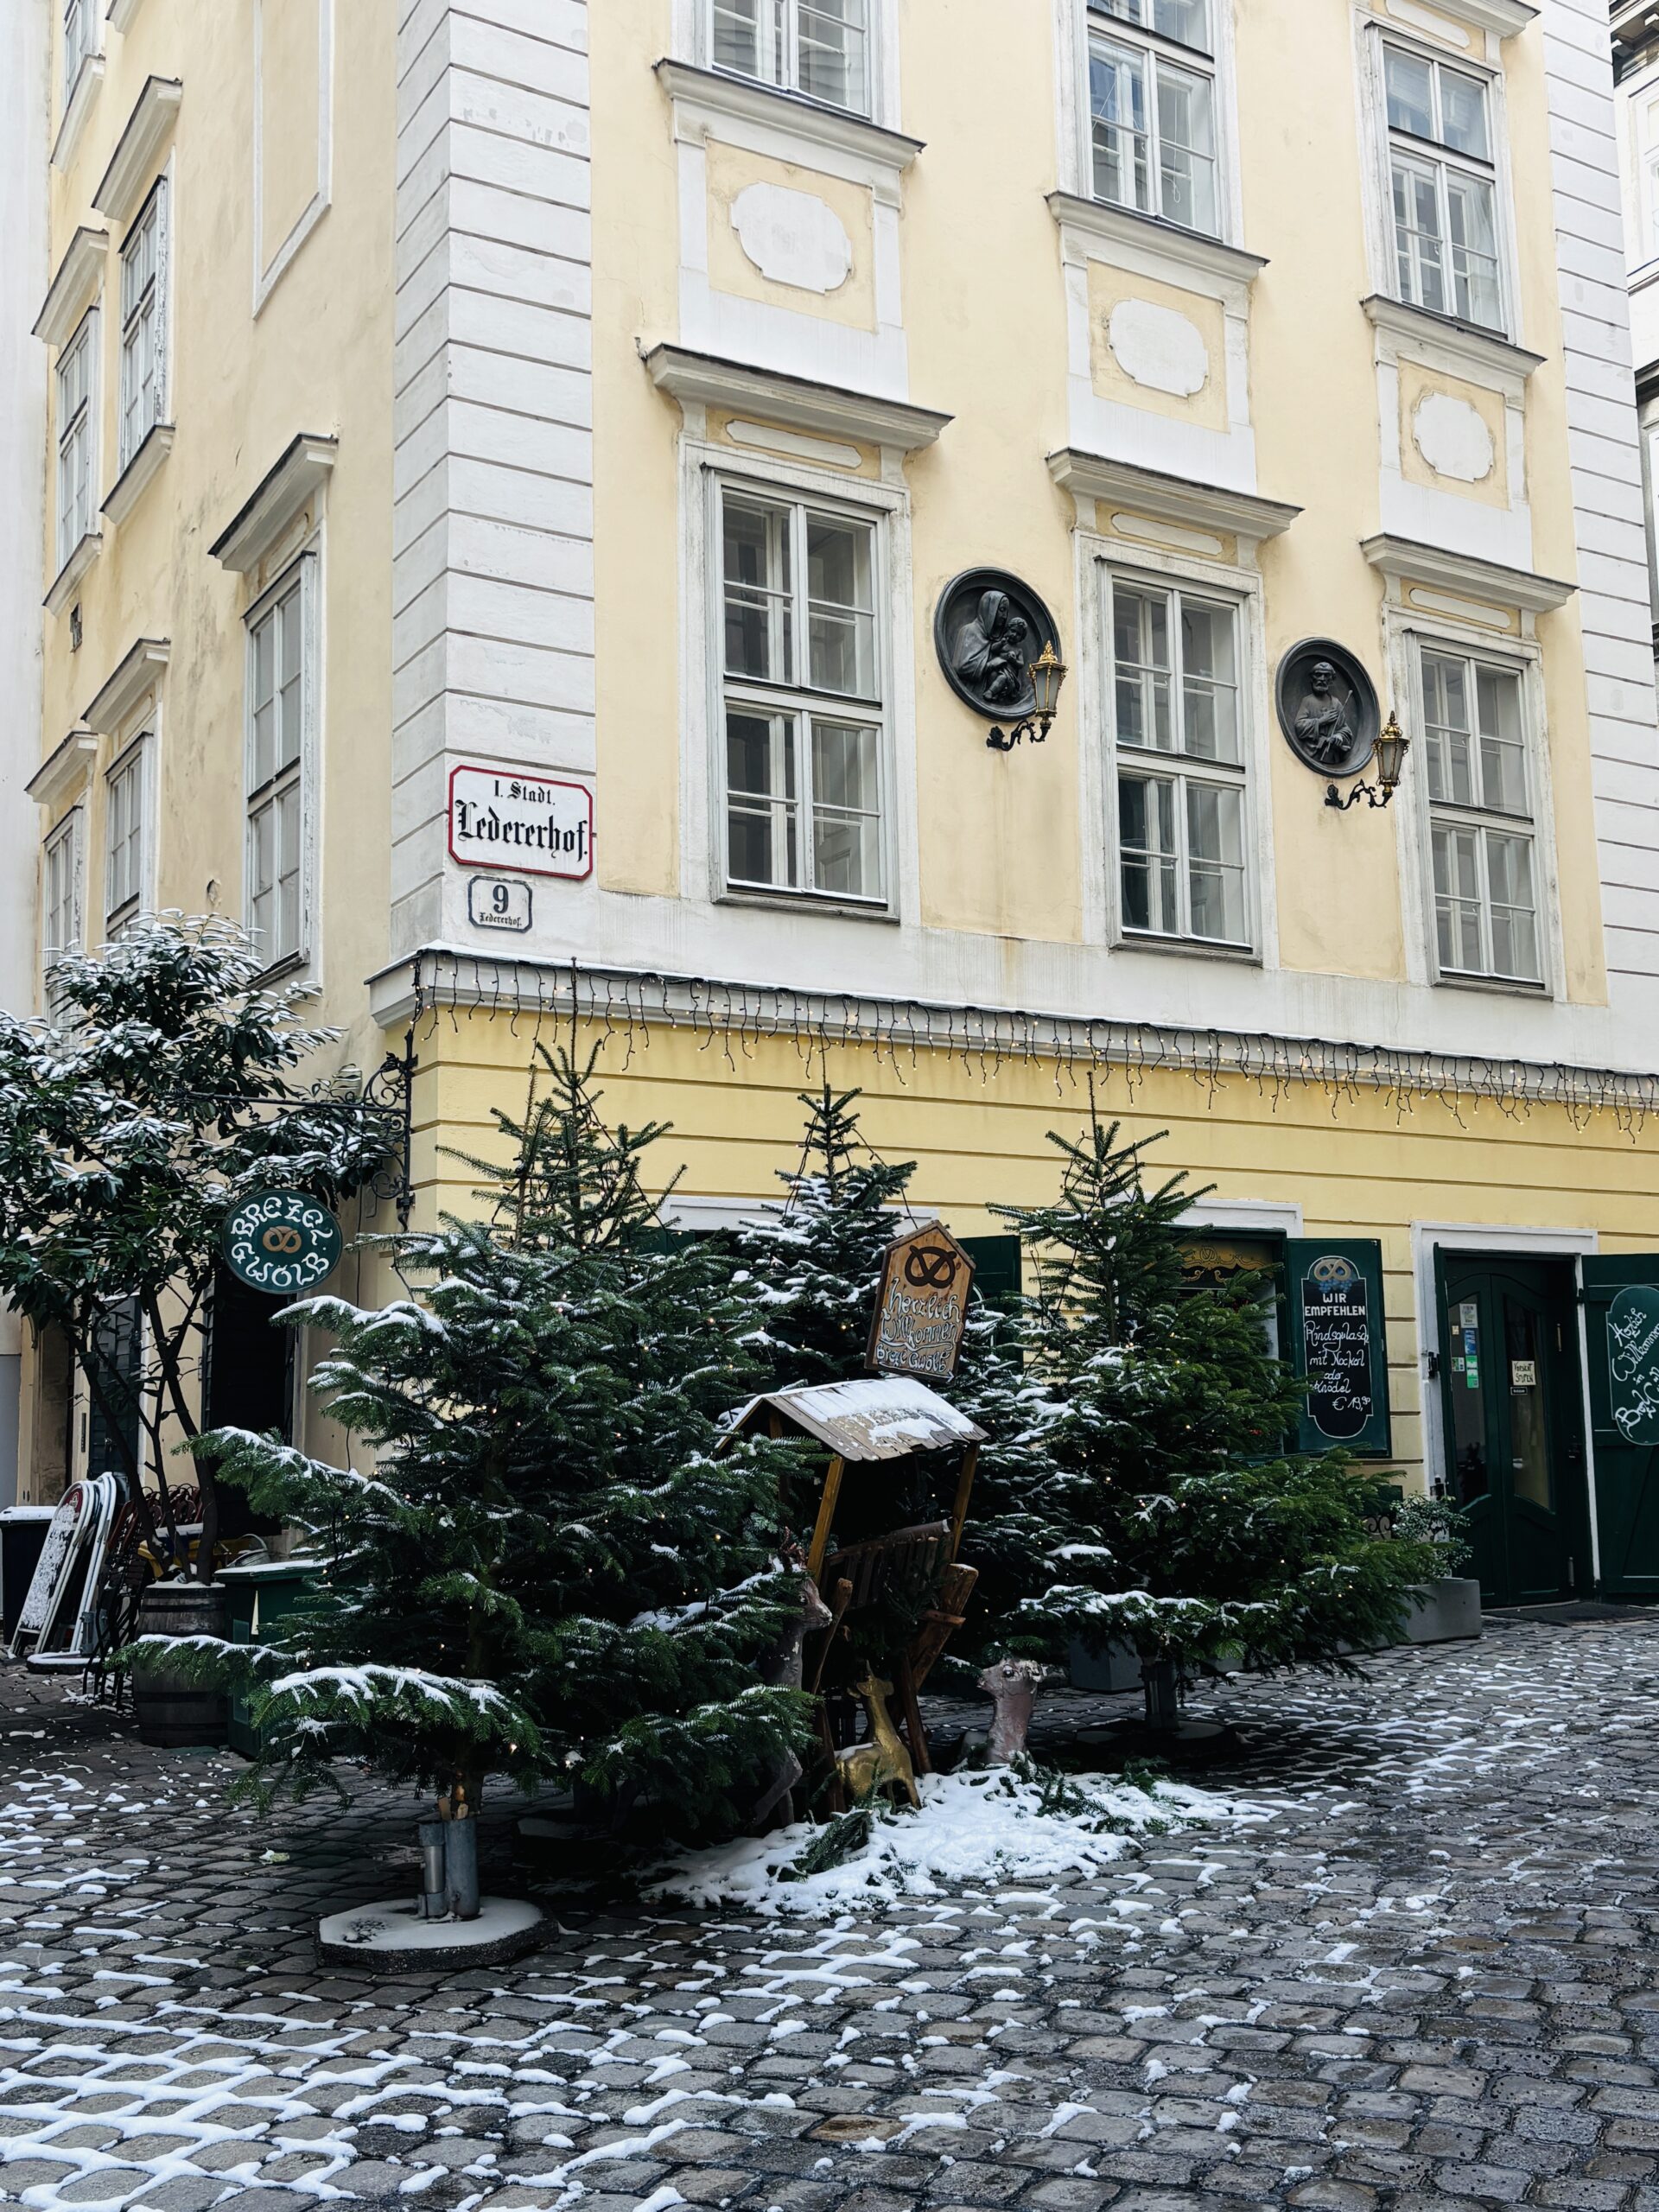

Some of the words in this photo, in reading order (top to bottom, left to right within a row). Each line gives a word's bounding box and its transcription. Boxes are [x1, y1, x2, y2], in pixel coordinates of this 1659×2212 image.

[454, 798, 588, 862] Ledererhof.
[493, 884, 509, 914] 9
[231, 1242, 330, 1287] GWÖLB
[1323, 1293, 1347, 1304] WIR
[1304, 1305, 1366, 1317] EMPFEHLEN
[1309, 1349, 1328, 1366] mit
[1323, 1369, 1344, 1380] oder
[1313, 1377, 1351, 1394] Knödel
